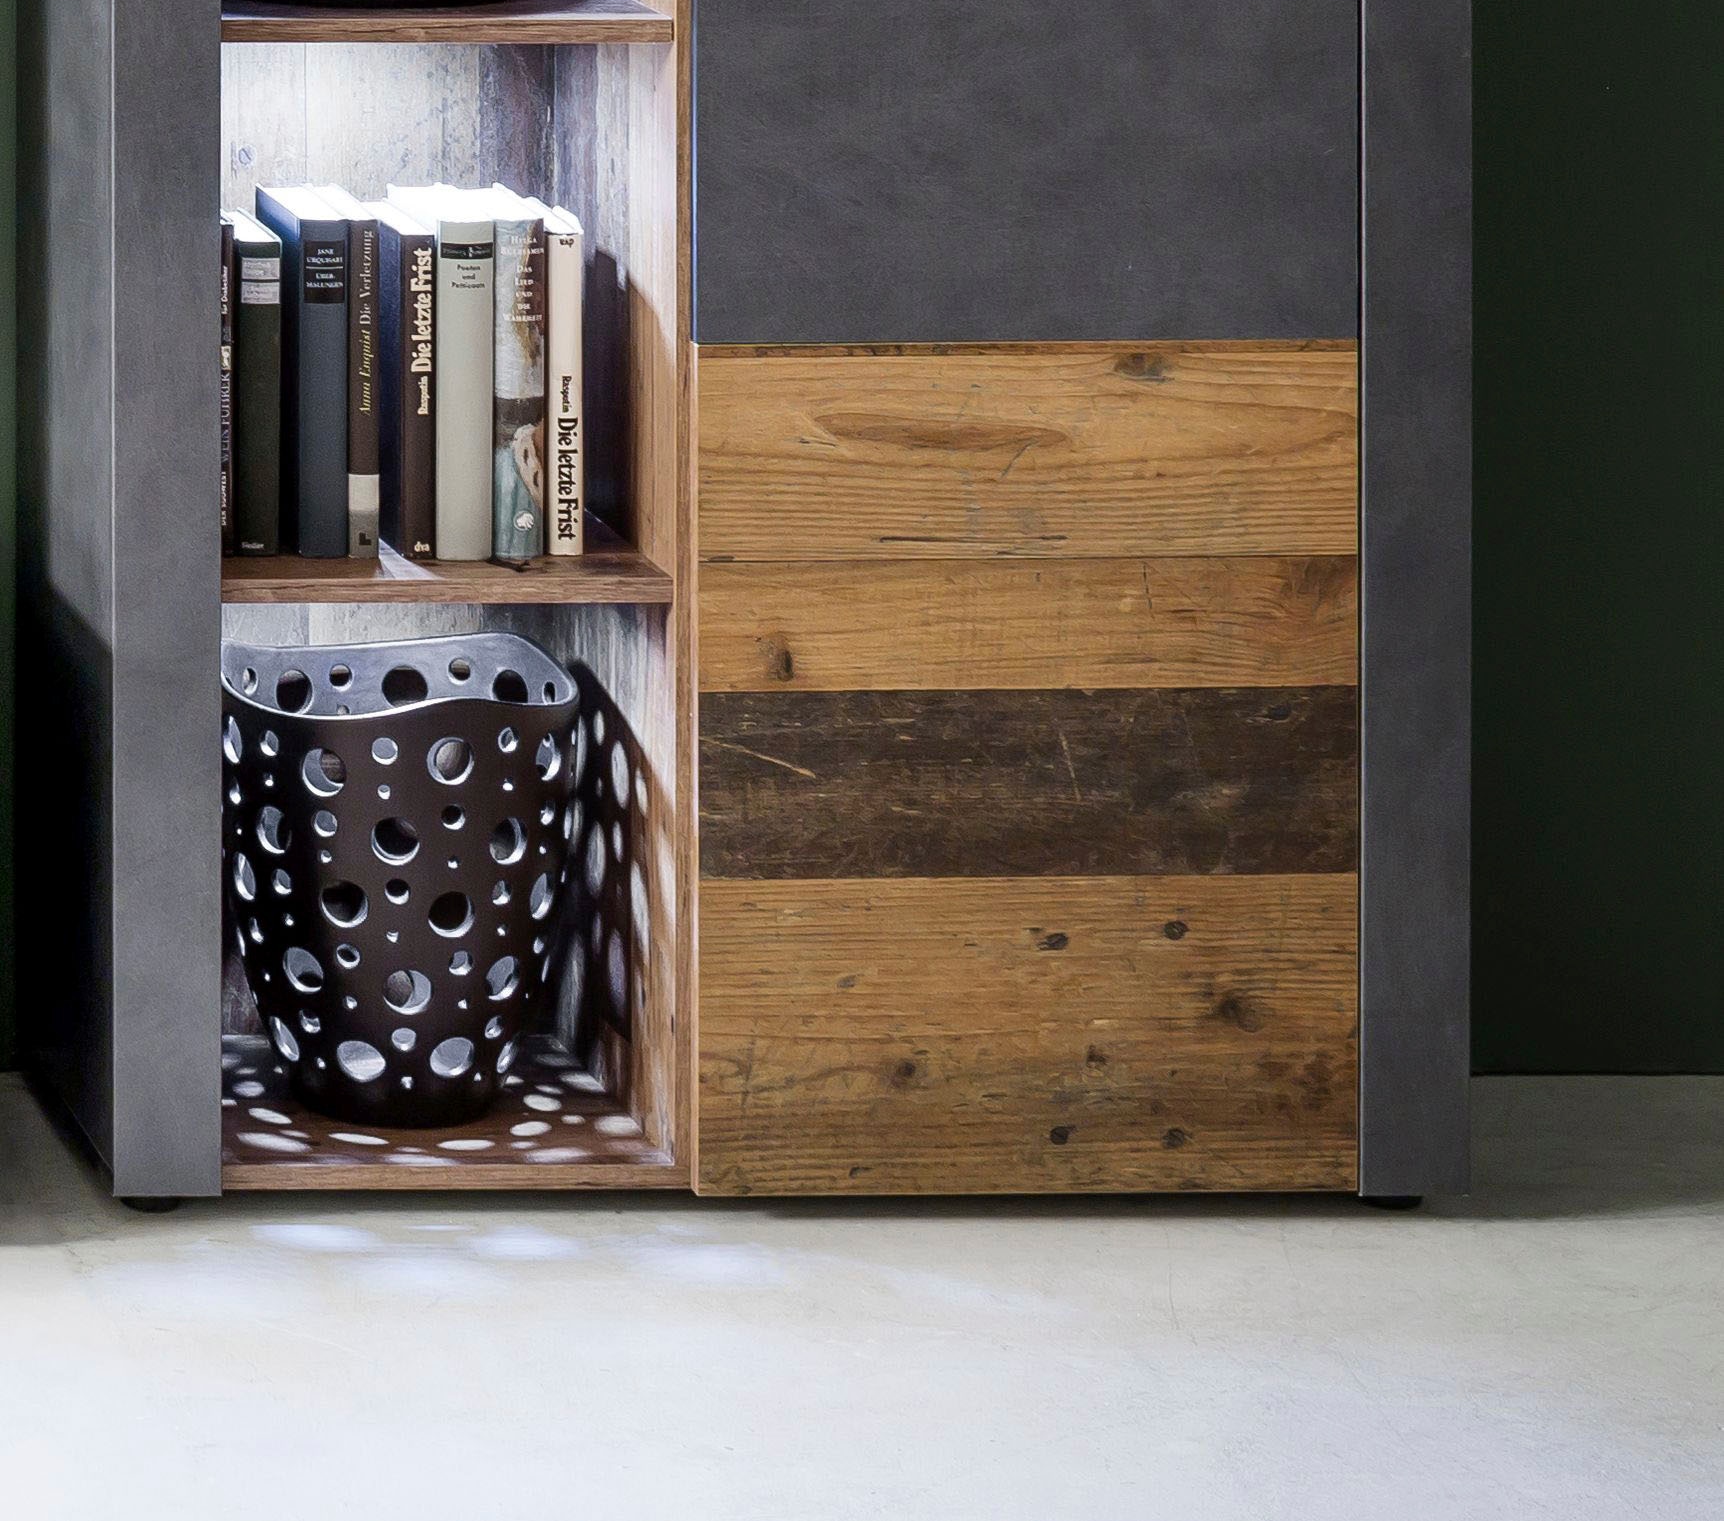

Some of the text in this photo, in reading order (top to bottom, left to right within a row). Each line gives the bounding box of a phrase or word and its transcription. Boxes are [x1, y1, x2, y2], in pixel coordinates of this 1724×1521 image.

[410, 246, 433, 292] Frist
[359, 230, 375, 416] Anna Enquist Die Verletzung
[411, 293, 433, 341] letzte
[411, 342, 433, 373] Die
[558, 416, 579, 446] Die
[558, 448, 579, 496] letzte
[557, 497, 579, 540] Frist
